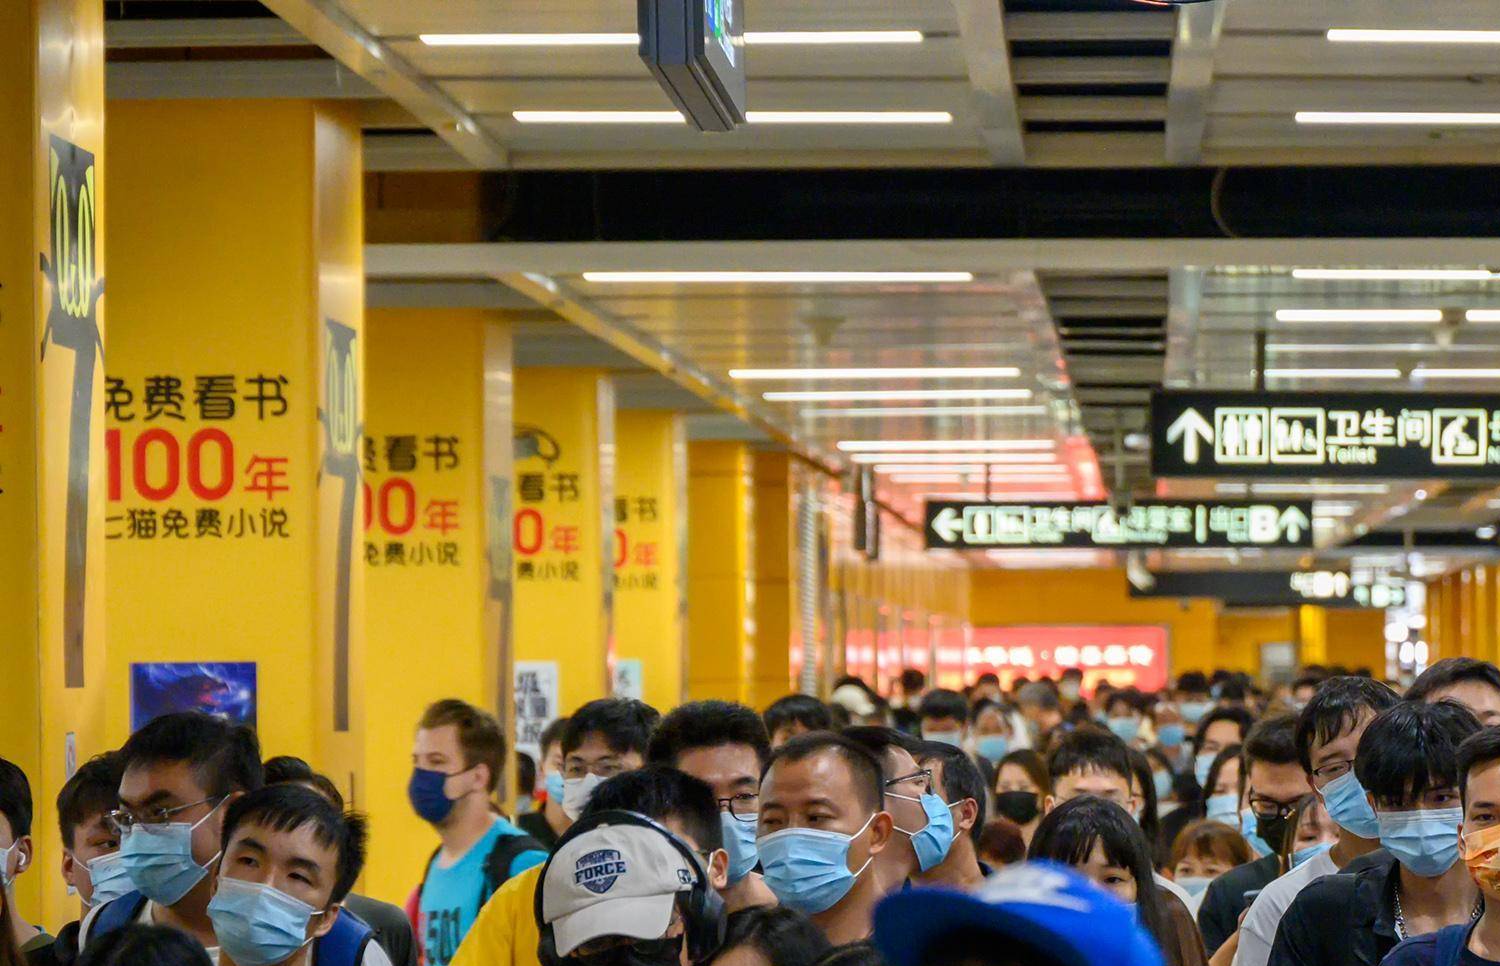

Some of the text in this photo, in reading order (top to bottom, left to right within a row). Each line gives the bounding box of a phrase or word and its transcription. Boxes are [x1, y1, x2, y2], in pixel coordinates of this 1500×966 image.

[105, 374, 289, 421] 免费看书
[1326, 408, 1432, 448] 卫生间
[1327, 445, 1377, 465] Toilet
[574, 861, 627, 885] FORCE
